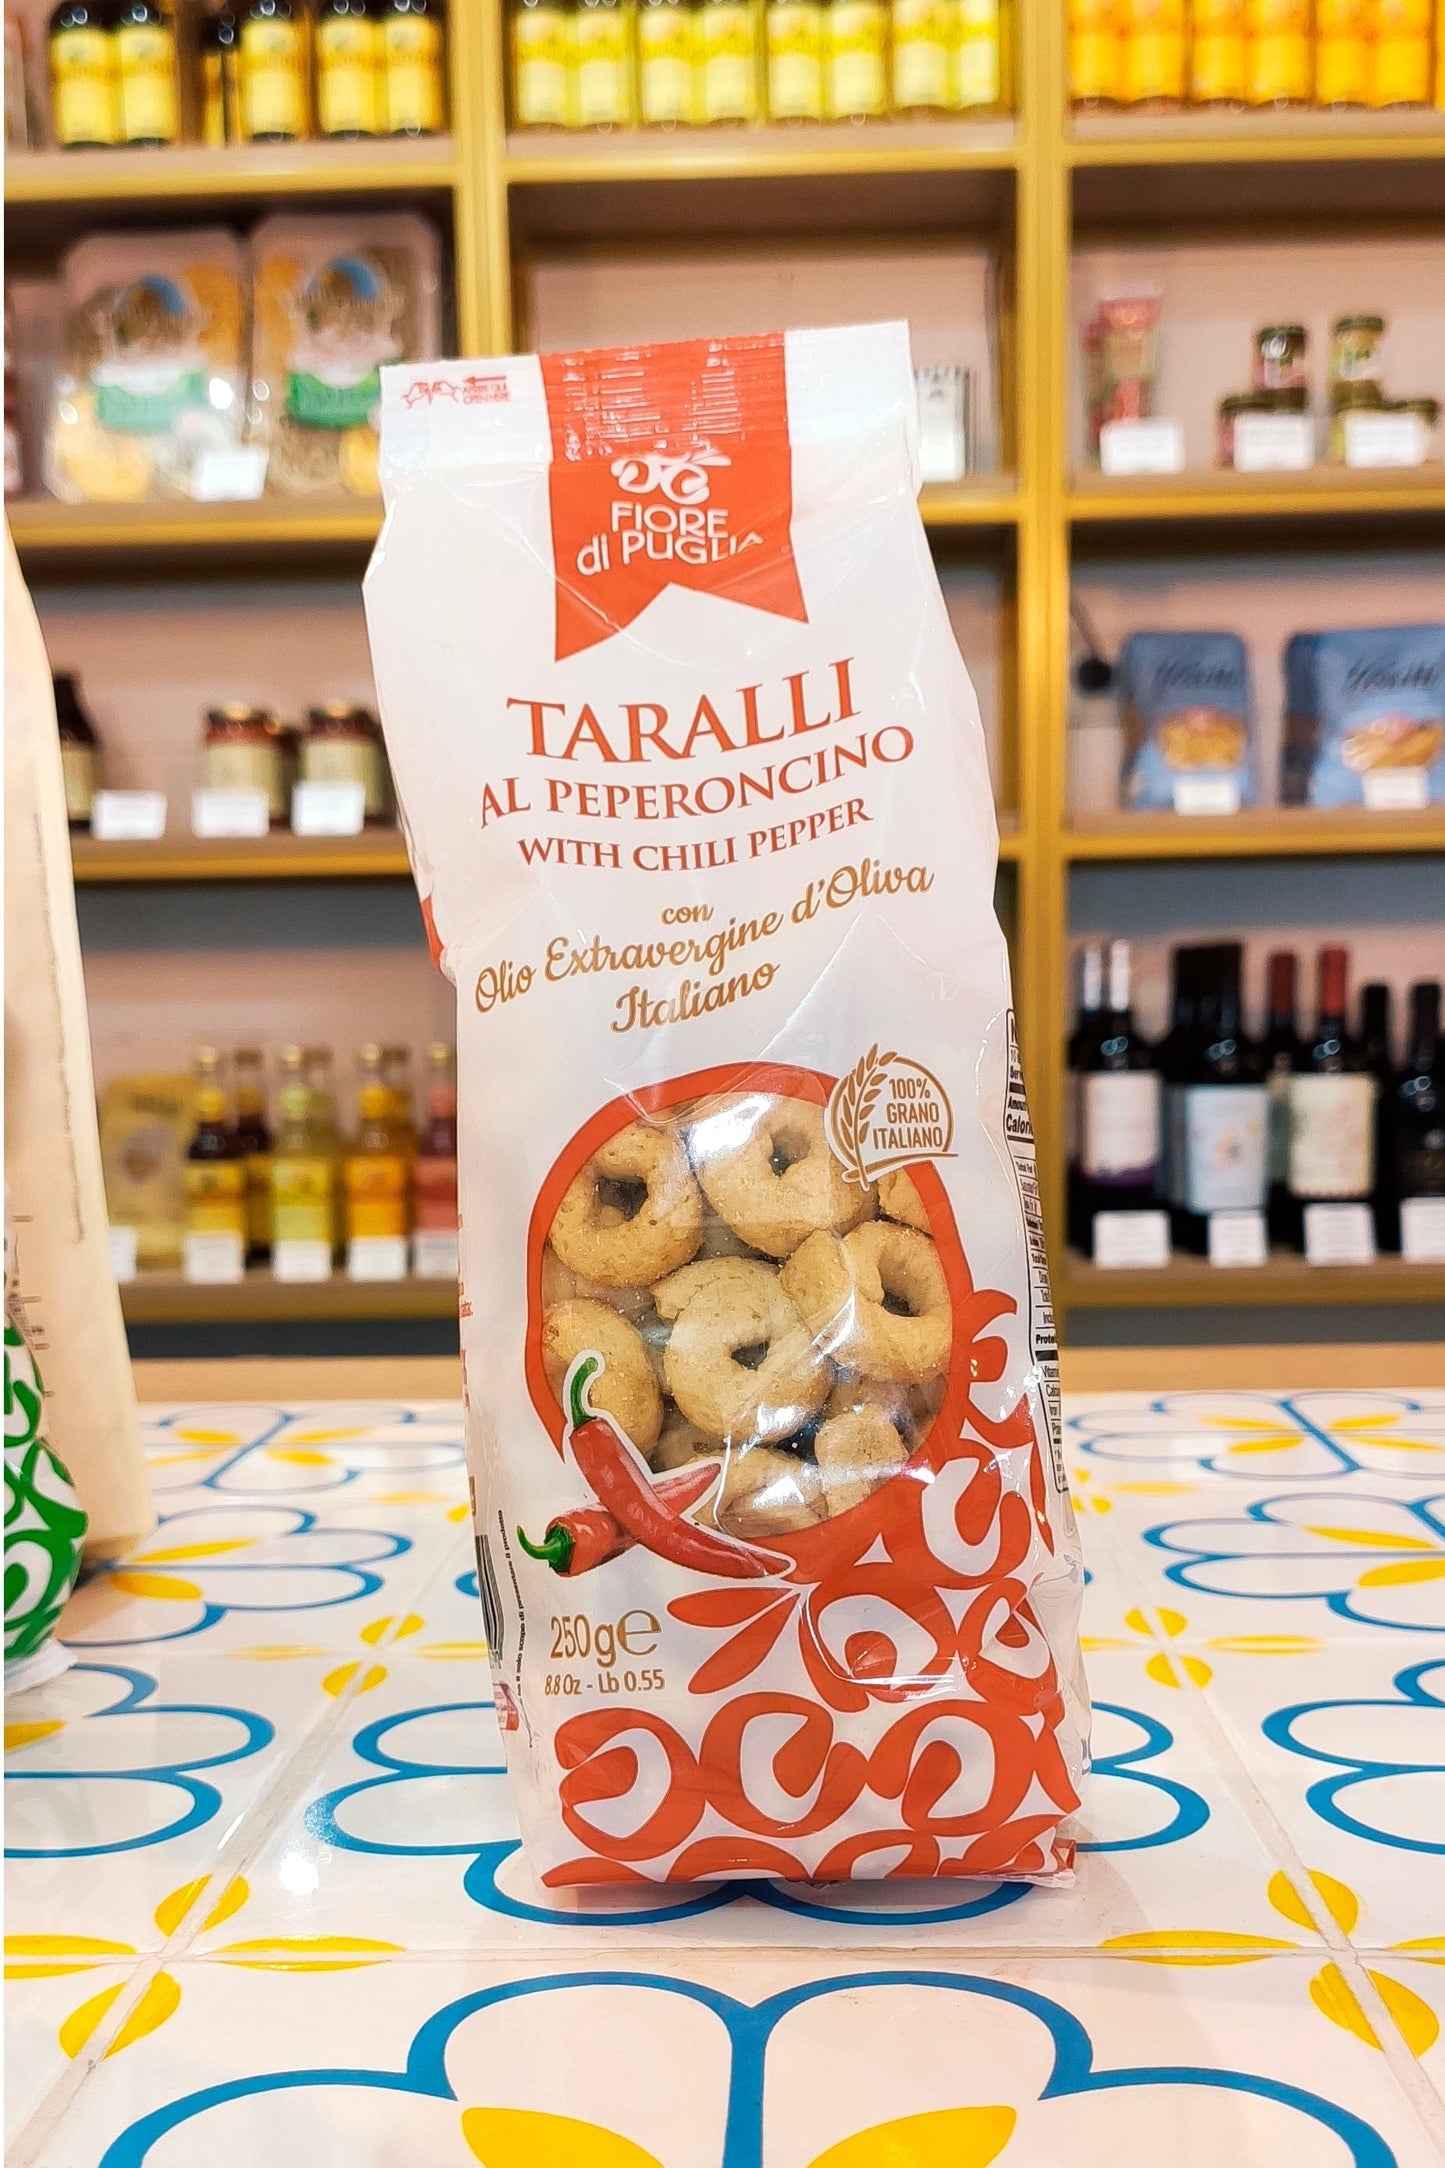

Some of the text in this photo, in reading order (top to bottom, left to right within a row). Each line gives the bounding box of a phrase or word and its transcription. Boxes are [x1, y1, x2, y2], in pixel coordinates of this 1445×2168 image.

[611, 500, 729, 539] FIORE
[576, 529, 764, 576] di PUGLIA
[506, 656, 862, 764] TARALLI
[480, 725, 915, 830] AL PEPERONCINO
[516, 797, 874, 872] WITH CHILI PEPPER
[474, 856, 935, 1014] Olio Extravergine d'Oliva
[660, 903, 714, 926] con
[610, 961, 780, 1034] Italiano
[888, 1077, 932, 1100] 100%
[886, 1102, 941, 1125] GRANO
[872, 1126, 943, 1151] ITALIANO
[597, 1670, 620, 1695] Lb
[623, 1668, 666, 1693] 0.55
